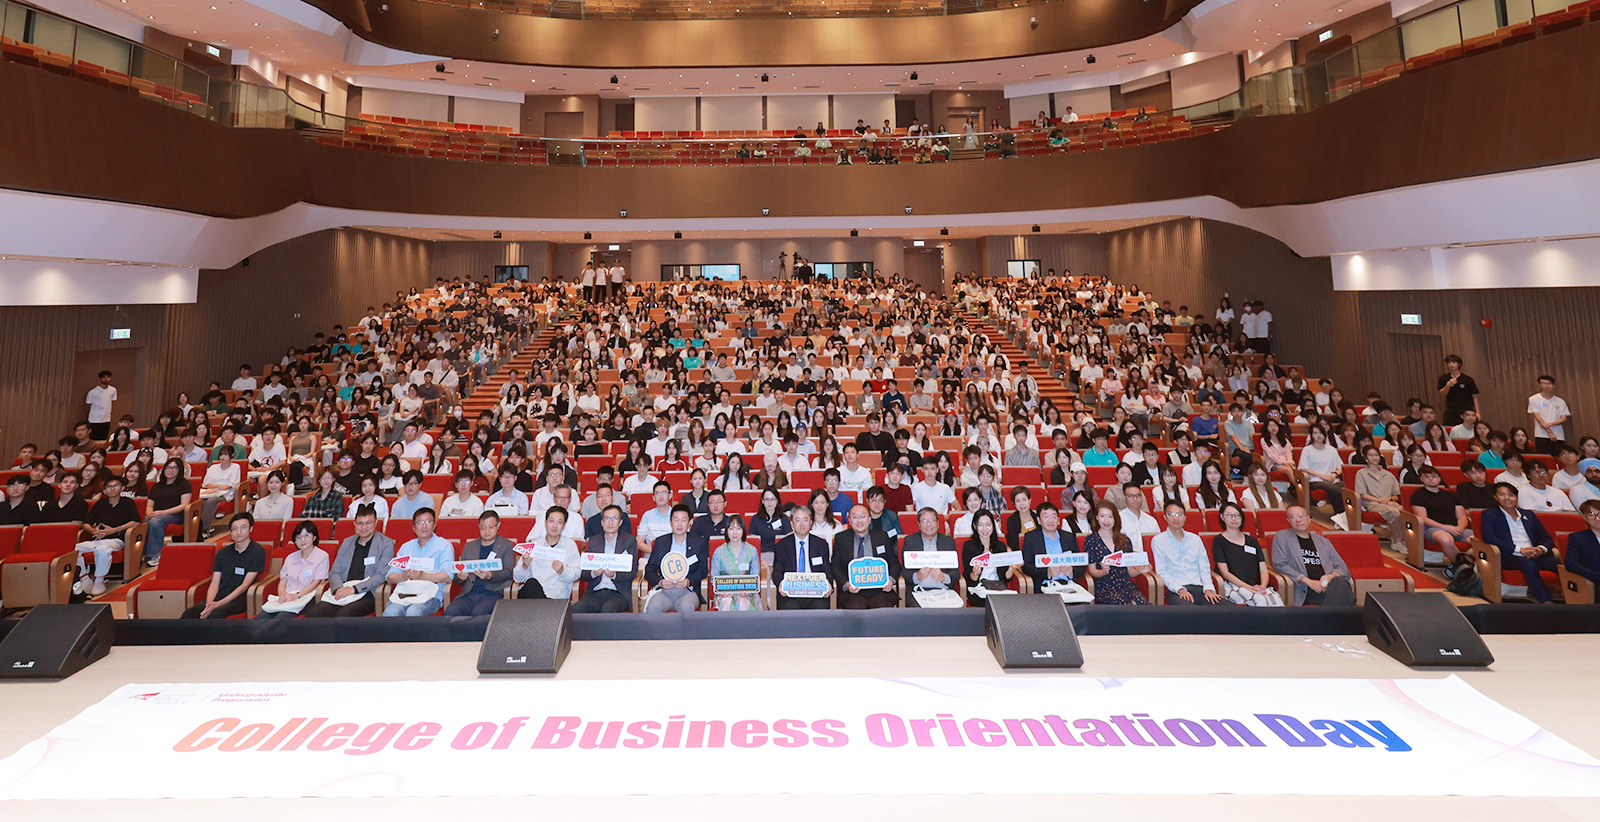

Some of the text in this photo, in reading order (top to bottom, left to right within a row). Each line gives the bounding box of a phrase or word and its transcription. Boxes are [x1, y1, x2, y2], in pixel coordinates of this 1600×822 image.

[668, 560, 682, 574] CB
[853, 566, 884, 574] FUTURE
[855, 574, 884, 583] READY
[783, 581, 827, 591] BUSINESS
[173, 712, 1413, 756] College of Business Orientation Day
